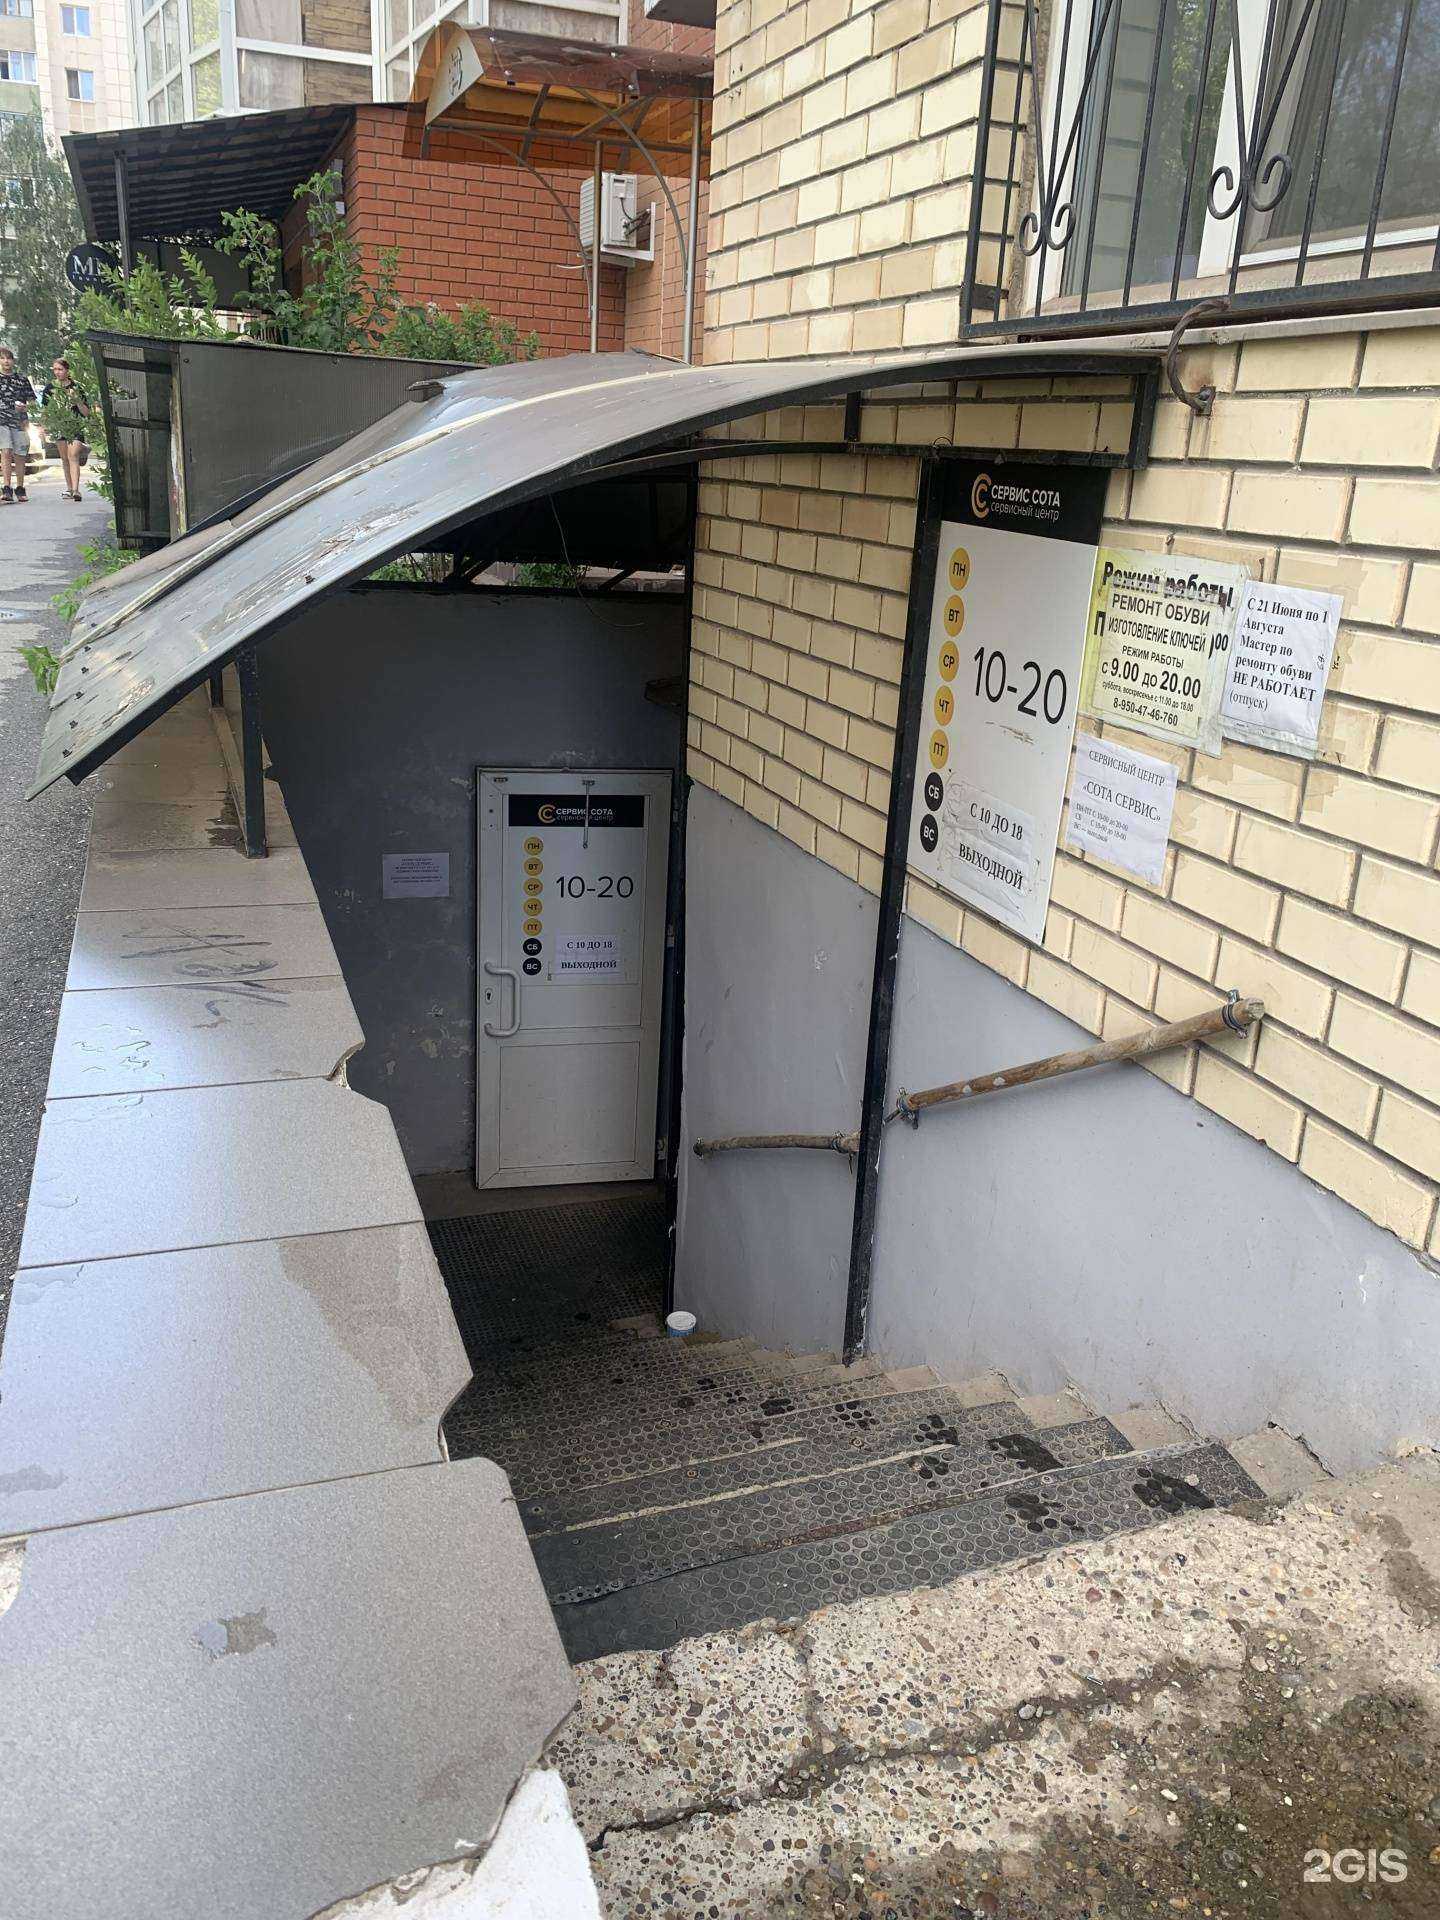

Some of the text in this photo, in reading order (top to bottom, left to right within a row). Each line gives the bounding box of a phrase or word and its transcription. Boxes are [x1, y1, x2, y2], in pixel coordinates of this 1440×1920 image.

[991, 484, 1060, 507] СЕРВИС СОТА
[991, 501, 1060, 522] сервисный центр
[952, 561, 966, 577] ПН
[948, 608, 960, 623] ВТ
[1112, 593, 1211, 627] РЕМОНТ ОБУВИ
[1247, 597, 1328, 623] С 21 Июня по 1
[1108, 616, 1208, 653] ИЗГОТОВЛЕНИЕ КЛЮЧЕЙ
[1243, 617, 1284, 635] Августа
[1122, 645, 1185, 669] РЕЖИМ РАБОТЫ
[1240, 634, 1293, 657] Мастер по
[943, 655, 955, 669] СР
[1235, 656, 1313, 681] ремонту обуви
[974, 646, 1067, 724] 10-20
[1110, 658, 1139, 682] 9.00
[1141, 672, 1157, 688] до
[1160, 670, 1201, 698] 20.00
[1233, 671, 1317, 701] НЕ РАБОТАЕТ
[939, 699, 950, 714] ЧТ
[1113, 697, 1179, 726] 8-950-47-46-760
[1229, 688, 1269, 712] (отпуск)
[934, 742, 946, 757] ПТ
[1089, 750, 1165, 787] СЕРВИСНЫЙ ЦЕНТР
[929, 784, 940, 800] СБ
[591, 808, 614, 816] СОТА
[1115, 792, 1161, 822] СЕРВИС»
[970, 802, 1024, 841] С 10 ДО 18
[923, 825, 935, 842] ВС
[527, 842, 540, 850] ПН
[527, 863, 538, 871] ВТ
[959, 842, 1024, 891] ВЫХОДНОЙ
[556, 875, 634, 898] 10-20
[566, 941, 613, 951] С 10 ДО 18
[526, 962, 538, 970] ВС
[561, 960, 617, 970] ВЫХОДНОЙ
